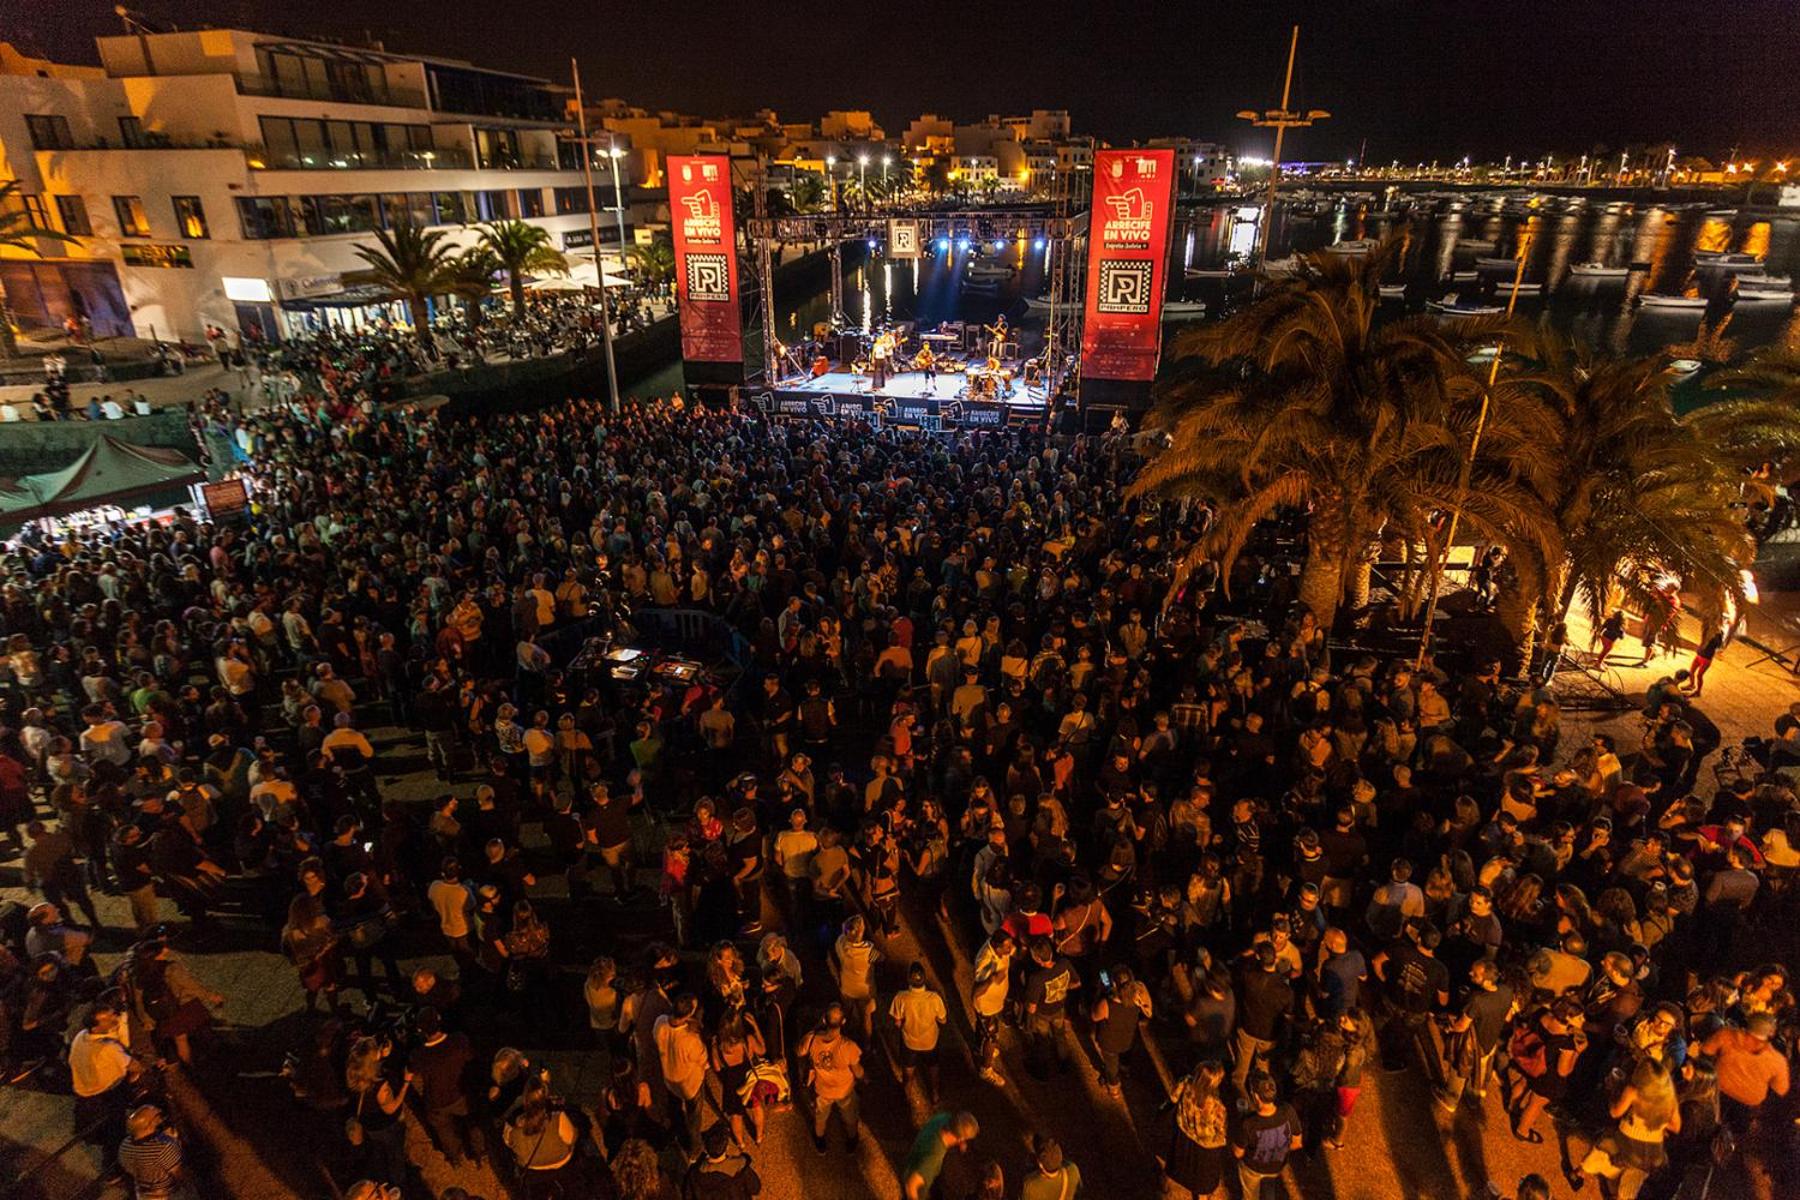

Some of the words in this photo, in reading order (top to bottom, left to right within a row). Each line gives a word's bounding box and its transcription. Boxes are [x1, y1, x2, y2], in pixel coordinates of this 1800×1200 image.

[1104, 220, 1151, 230] ARRECIFE
[684, 227, 695, 237] EN
[696, 227, 721, 237] VIVO
[1104, 230, 1118, 240] EN
[1120, 230, 1150, 241] VIVO
